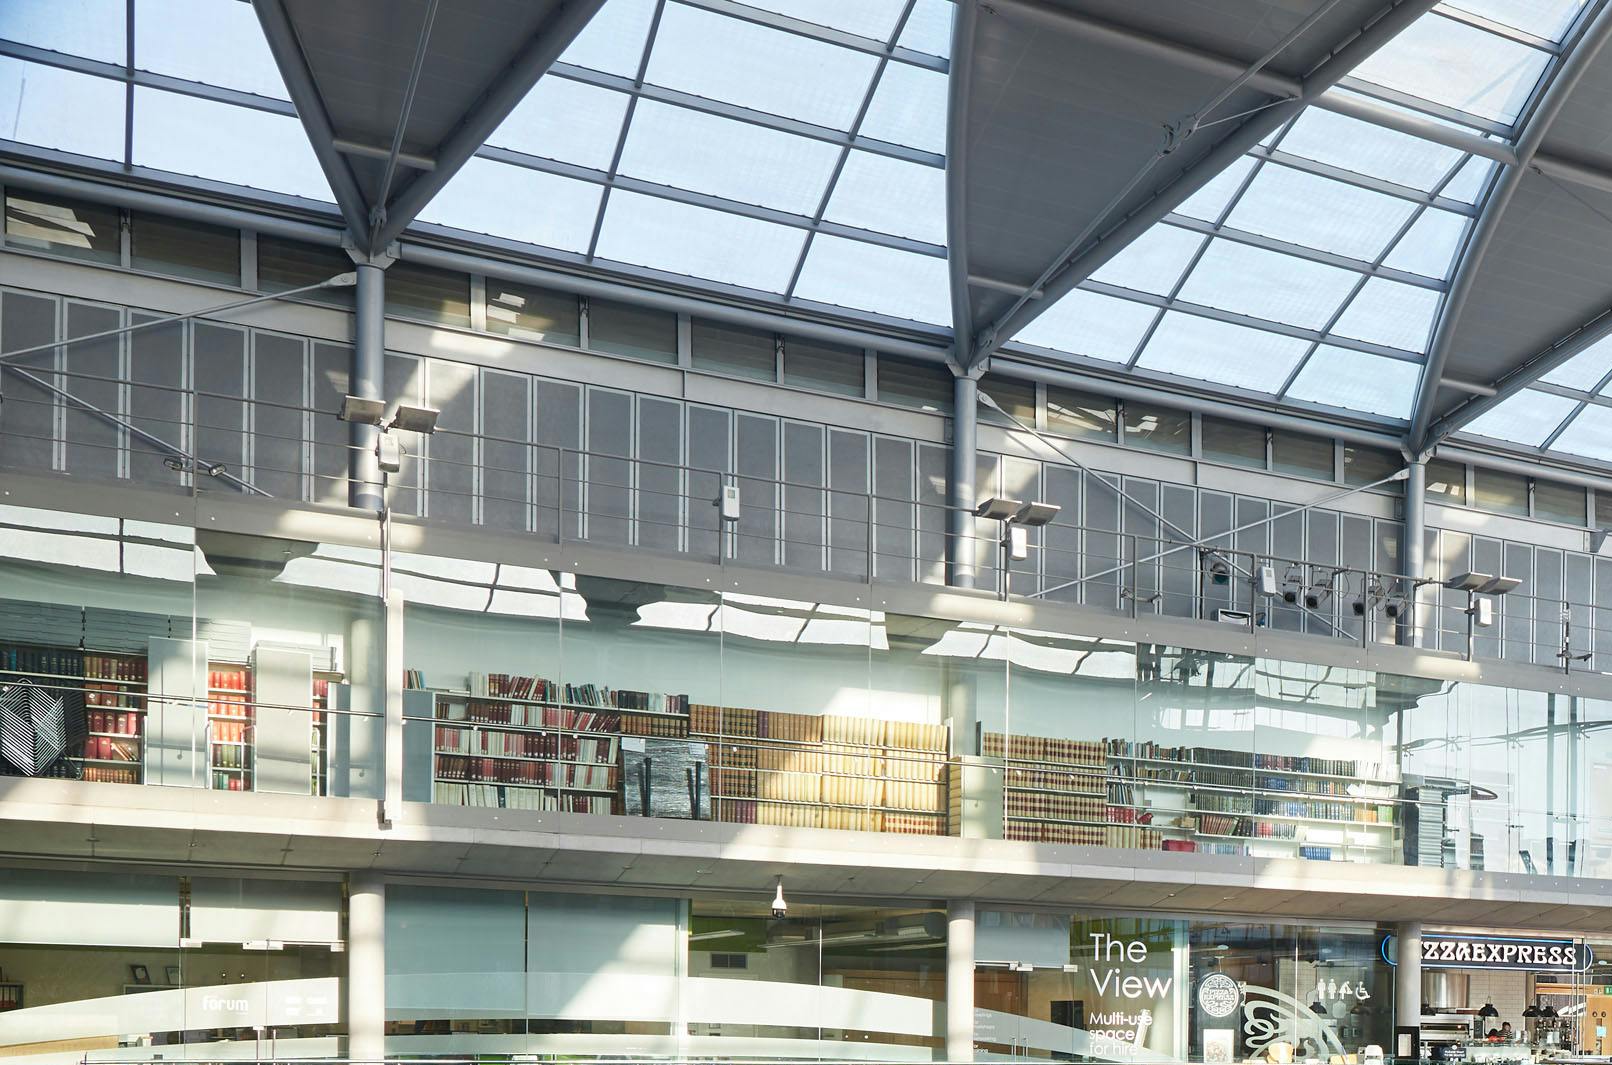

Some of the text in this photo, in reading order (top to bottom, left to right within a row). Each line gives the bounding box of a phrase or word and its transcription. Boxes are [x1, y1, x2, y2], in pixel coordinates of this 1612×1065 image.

[1089, 933, 1148, 963] The
[1421, 941, 1577, 965] ZZAEXPRESS
[1089, 968, 1172, 999] View
[202, 994, 249, 1011] forum
[1089, 1012, 1153, 1026] Multi-use
[1089, 1029, 1136, 1044] space
[1089, 1042, 1137, 1056] for hire
